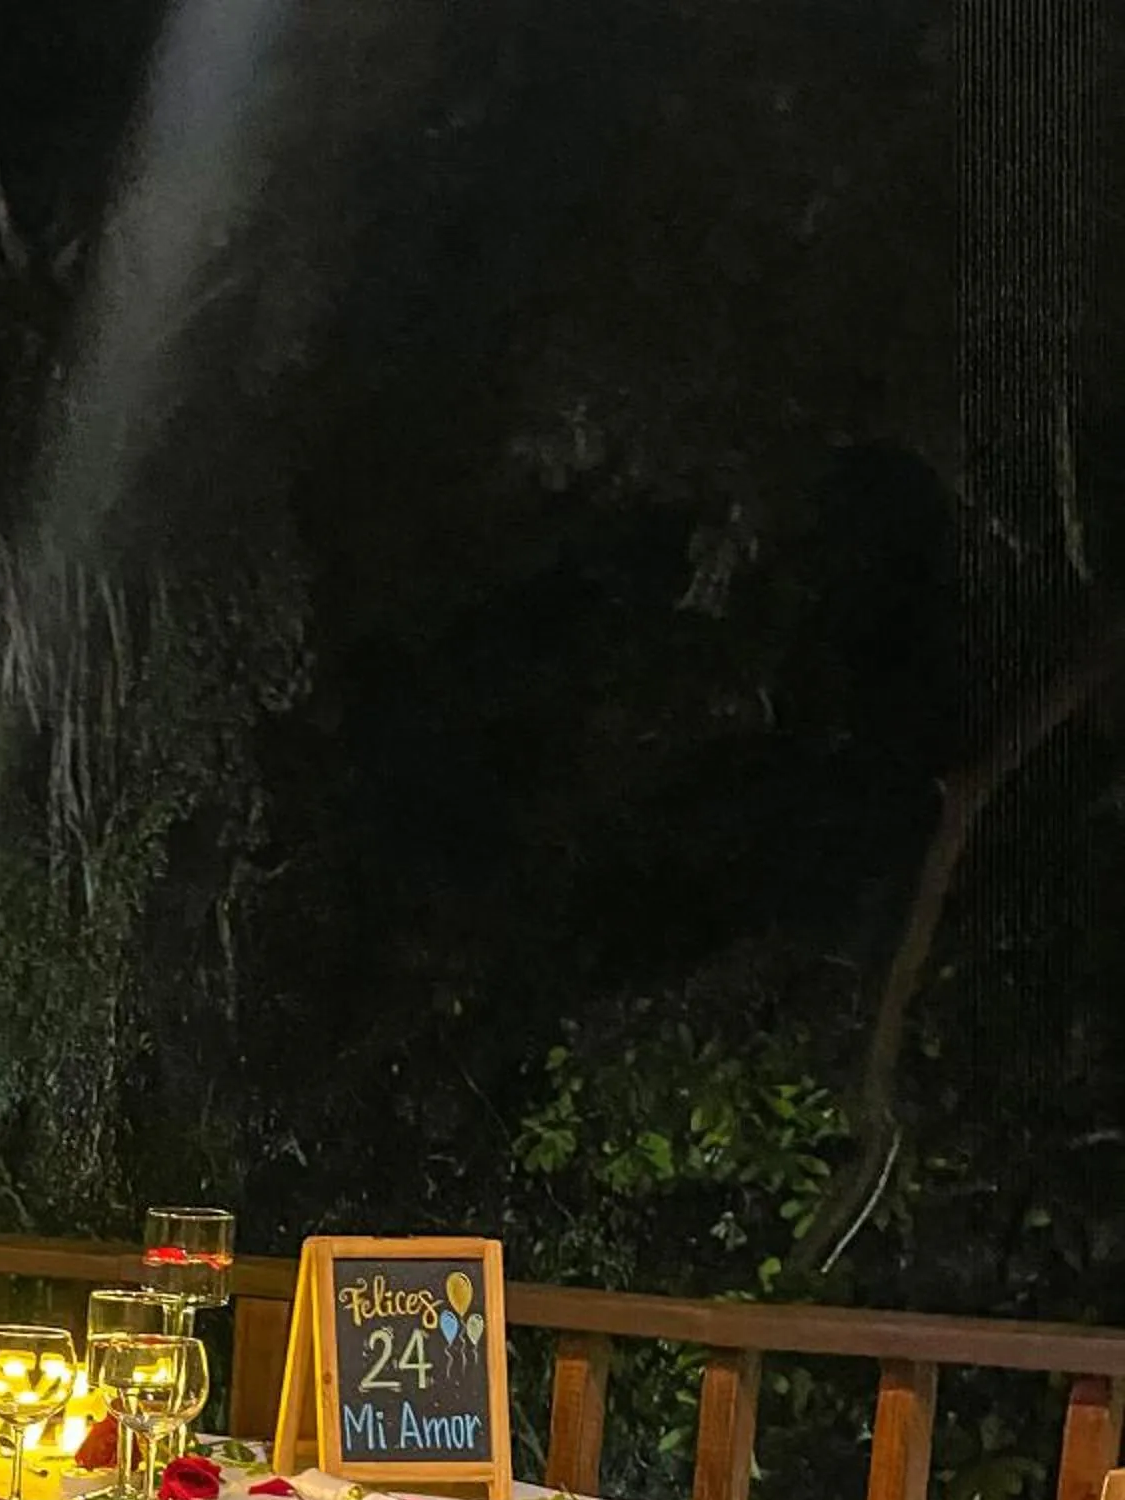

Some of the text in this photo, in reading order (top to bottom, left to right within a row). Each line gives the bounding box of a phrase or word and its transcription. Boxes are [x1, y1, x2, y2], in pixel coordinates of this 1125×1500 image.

[339, 1276, 442, 1330] Felices
[358, 1326, 434, 1393] 24
[343, 1401, 482, 1451] Mi Amor
